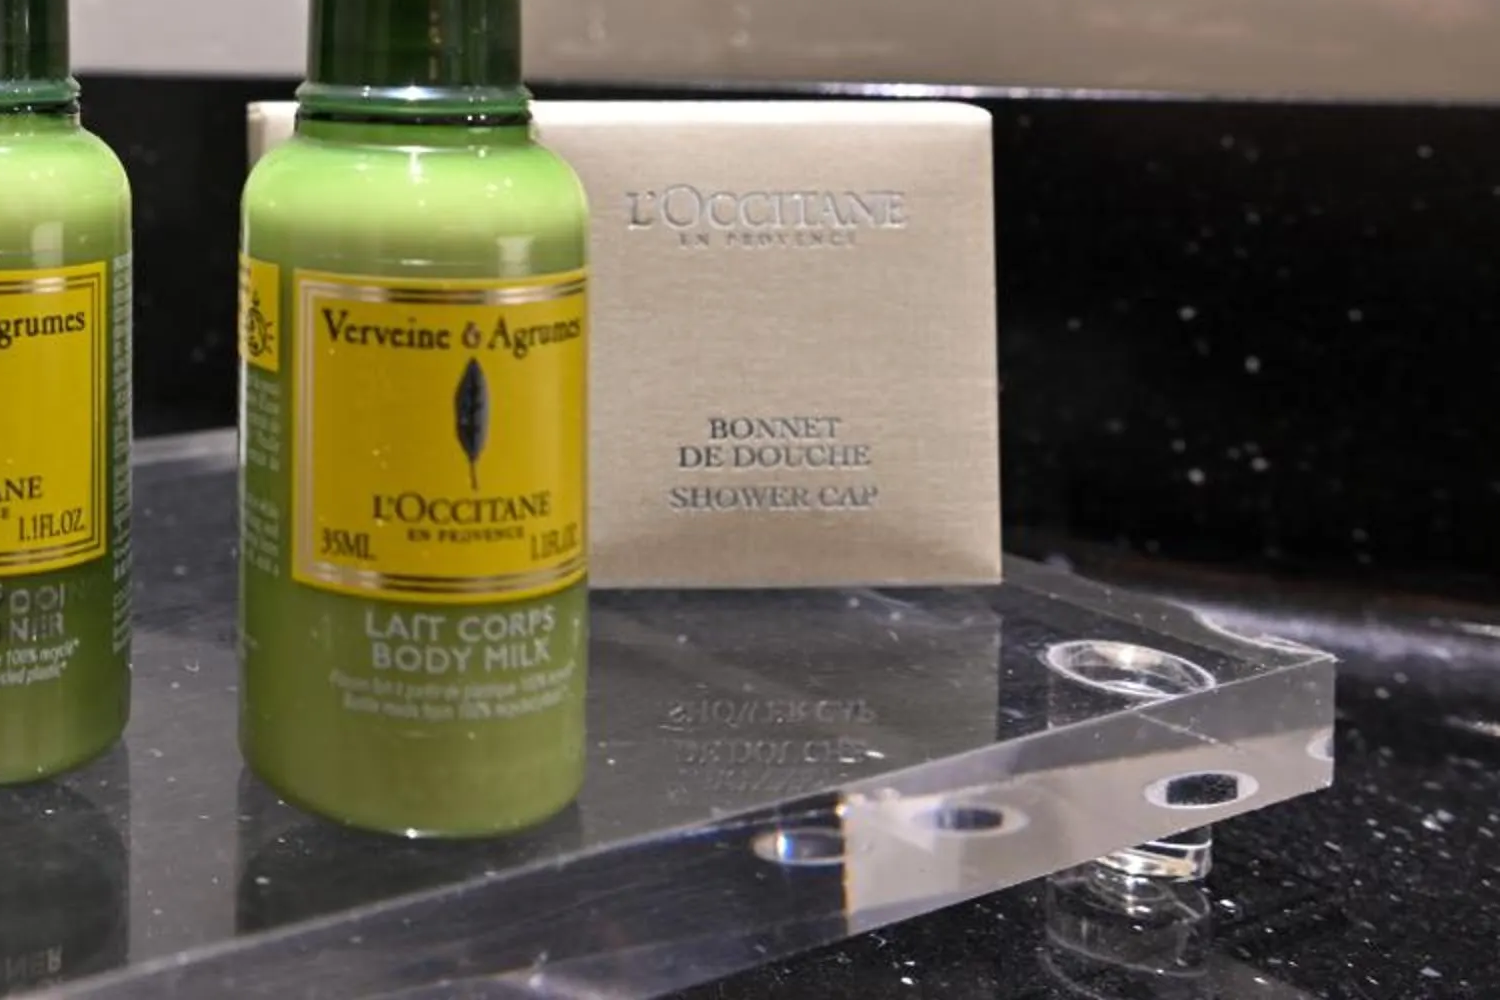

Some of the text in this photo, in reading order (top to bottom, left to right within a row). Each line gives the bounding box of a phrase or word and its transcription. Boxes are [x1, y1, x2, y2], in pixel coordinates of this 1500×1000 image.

[625, 184, 910, 231] L'OCCITANE
[322, 308, 451, 350] Verveine
[487, 315, 581, 359] Agrumes
[707, 416, 842, 441] BONNET
[677, 444, 873, 469] DE DOUCHE
[372, 489, 552, 524] L'OCCITANE
[667, 485, 880, 510] SHOWER CAP
[407, 525, 525, 544] EN PROVENCE
[364, 603, 556, 643] LAIT CORPS
[371, 637, 552, 675] BODY MILK
